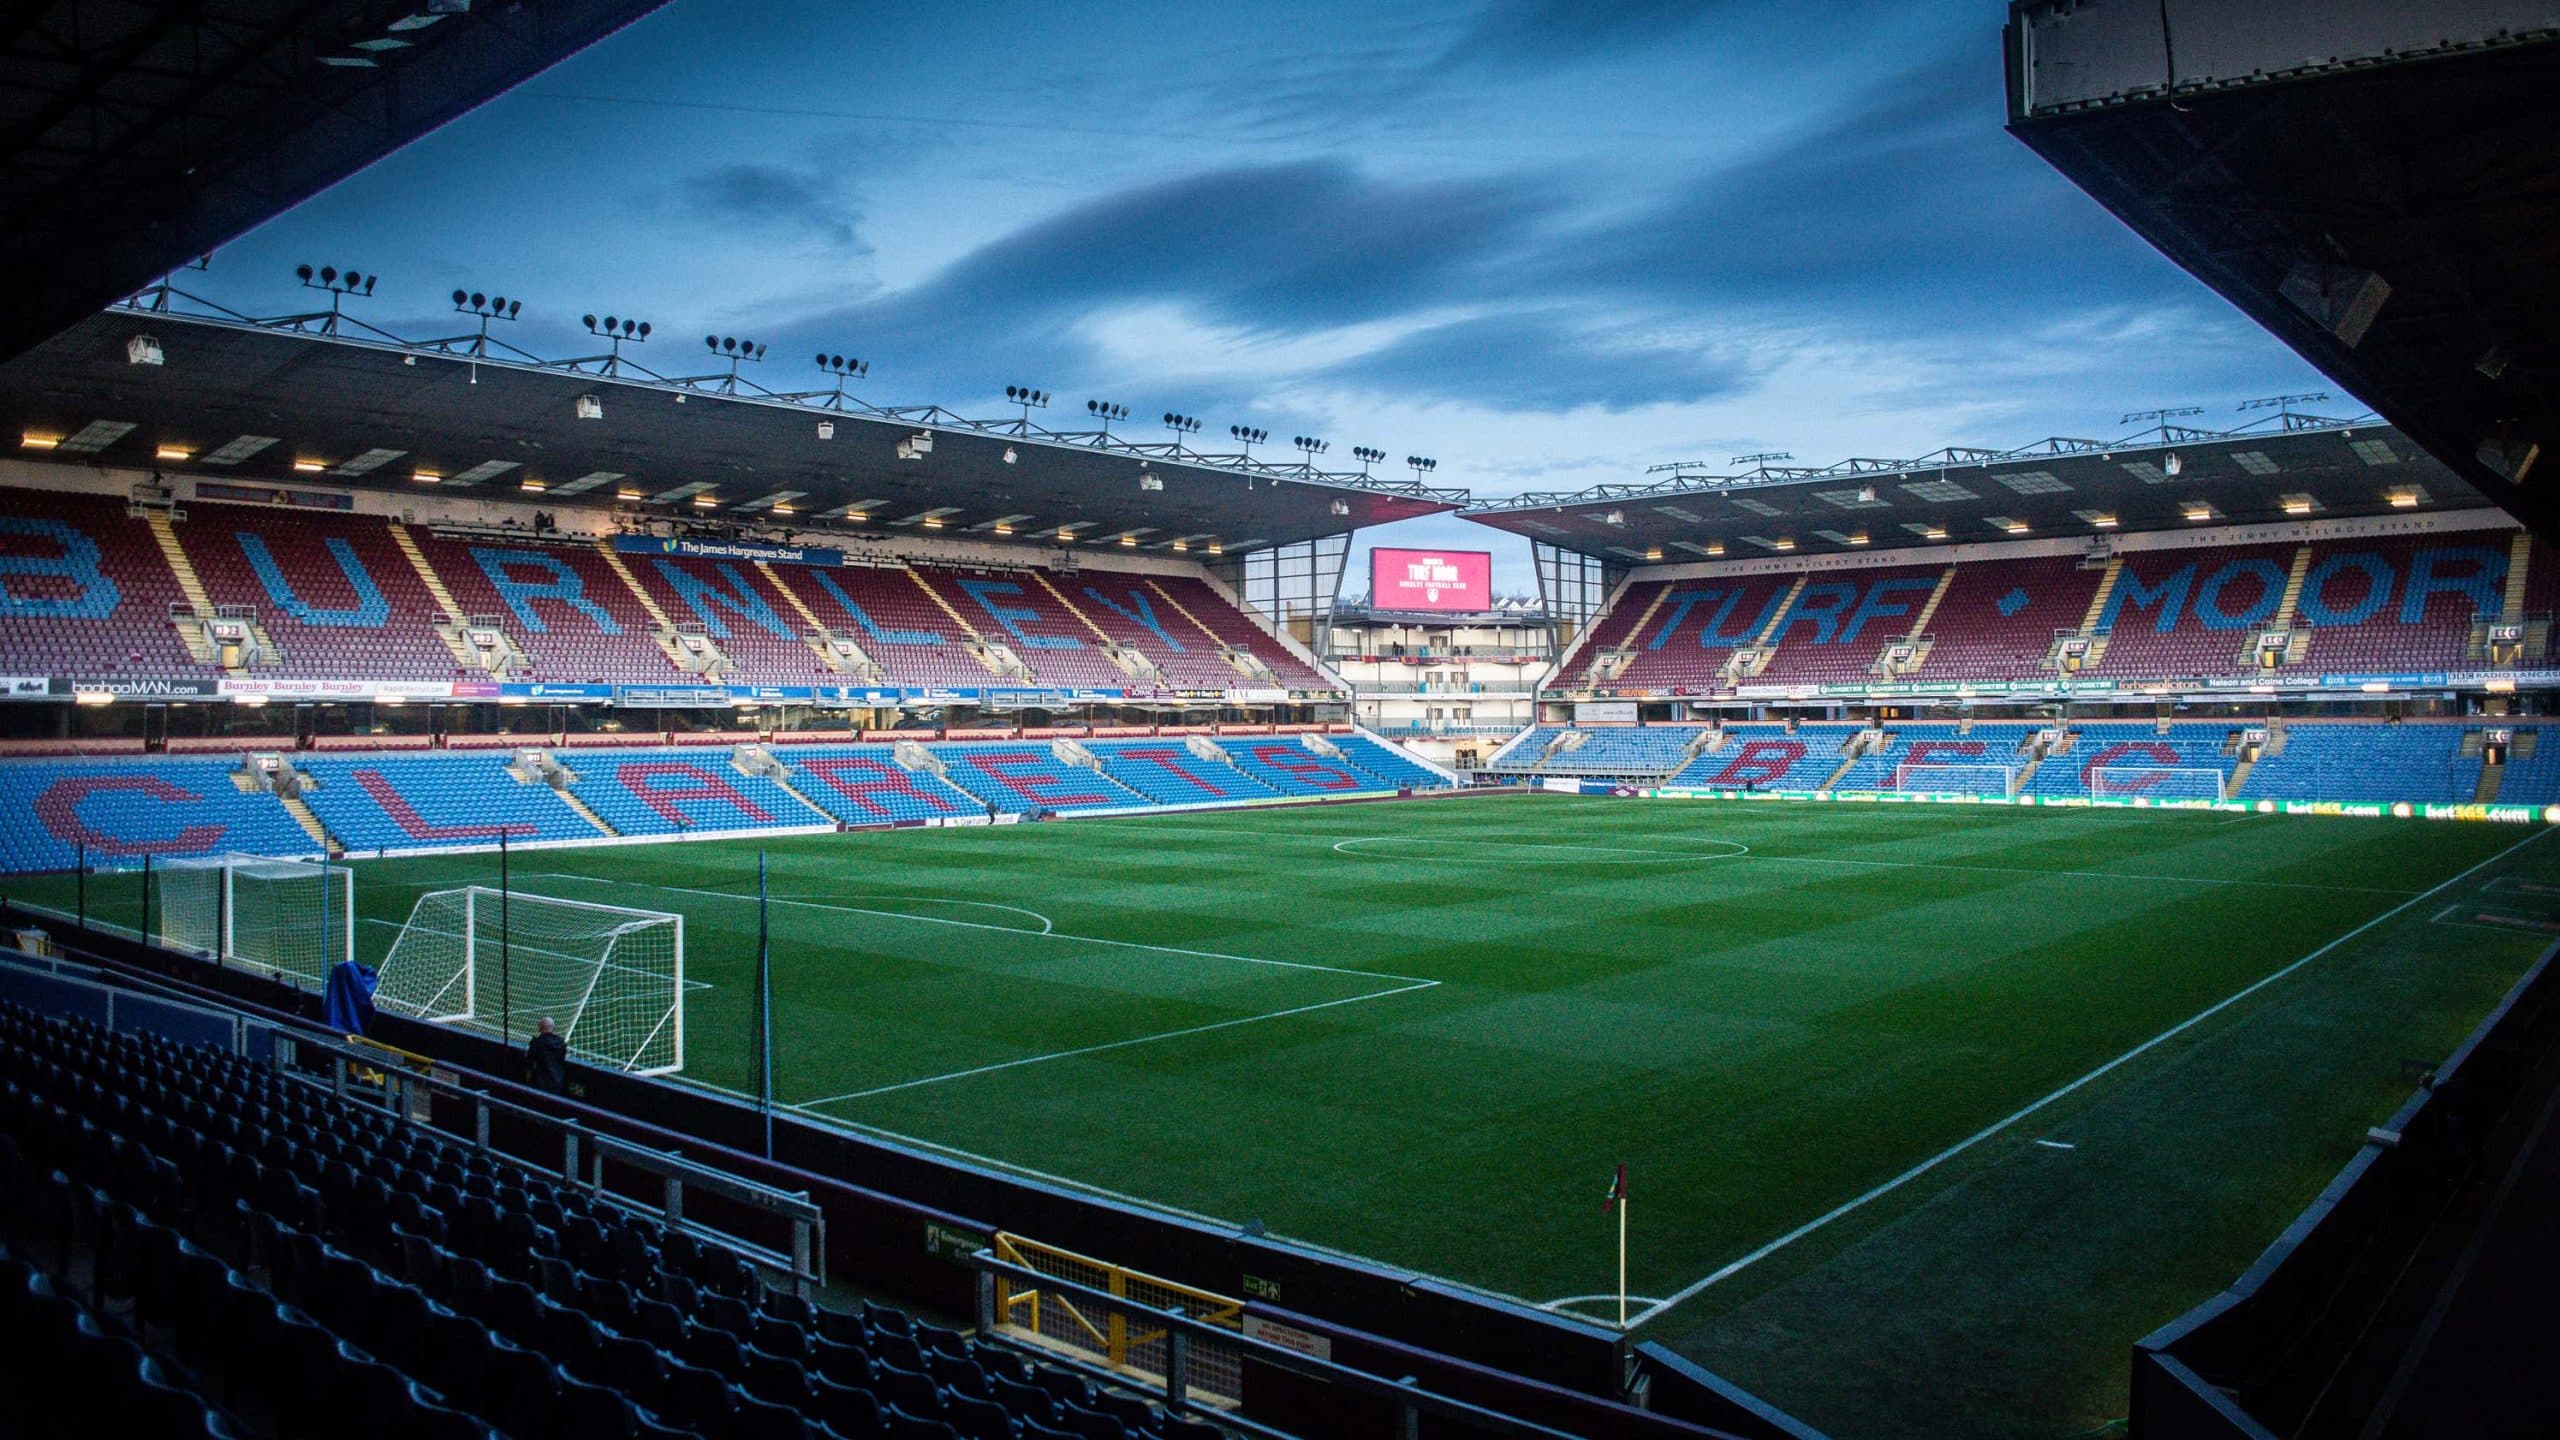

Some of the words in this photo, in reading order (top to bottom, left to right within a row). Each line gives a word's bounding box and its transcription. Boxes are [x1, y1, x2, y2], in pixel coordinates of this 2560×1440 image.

[2189, 535, 2218, 544] THE
[2228, 530, 2280, 541] JIMMY
[680, 541, 700, 553] The
[699, 542, 728, 556] James
[728, 545, 777, 560] Hargreaves
[777, 549, 803, 561] Stand
[0, 516, 1187, 653] BURNLEY
[1648, 577, 1942, 650] TURF
[2093, 546, 2510, 634] MOOR
[71, 680, 199, 695] boohooMAN.com
[224, 681, 270, 693] Burnley
[274, 682, 318, 693] Burnley
[322, 682, 364, 693] Burnley
[2209, 678, 2239, 687] Nelson
[2240, 678, 2257, 686] and
[2259, 677, 2284, 686] Colne
[2285, 676, 2320, 687] College
[34, 746, 1361, 856] CLARETS
[2286, 800, 2381, 817] bet365.com
[2424, 803, 2531, 824] bet365.com
